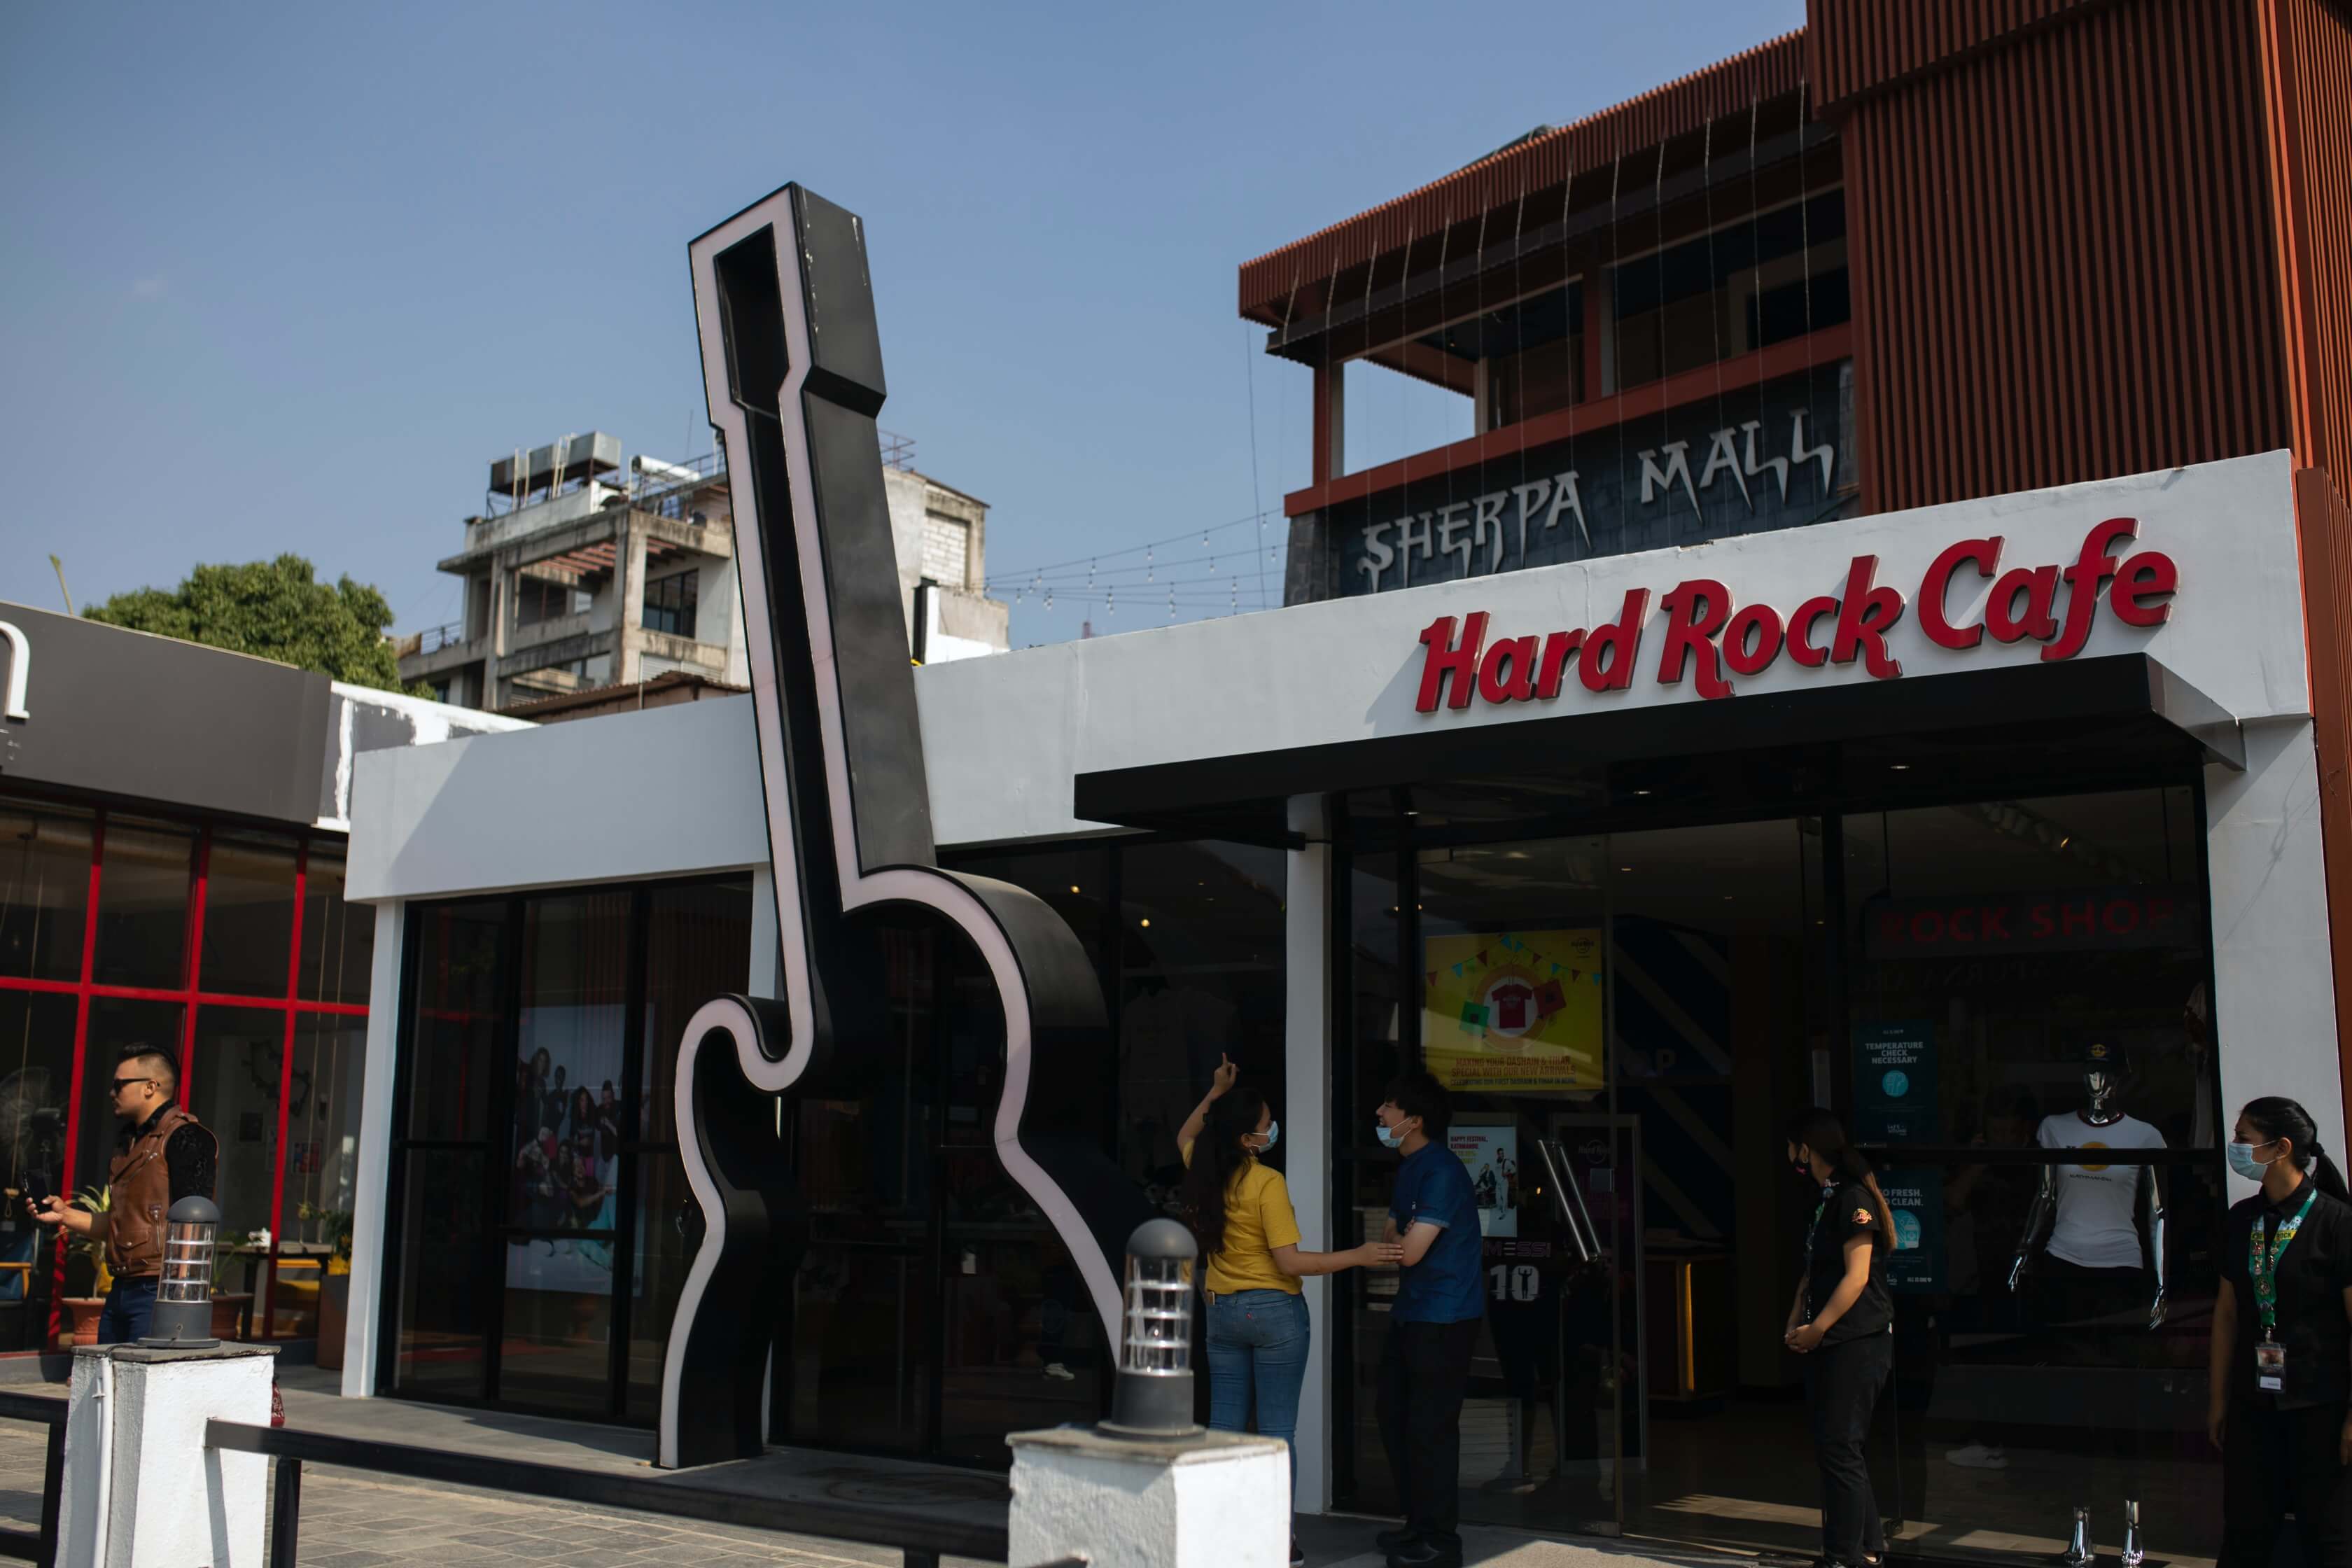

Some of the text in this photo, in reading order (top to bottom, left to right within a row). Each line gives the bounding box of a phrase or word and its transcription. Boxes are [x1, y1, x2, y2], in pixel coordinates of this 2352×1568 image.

[1359, 407, 1834, 594] SHERPA MALL
[1415, 517, 2179, 714] Hard Rock Cafe
[1881, 897, 2174, 943] ROCK SHOP
[1865, 1042, 1924, 1050] TEMPERATURE
[1872, 1056, 1918, 1065] NECESSARY
[1451, 1065, 1575, 1077] SPECIAL WITH OUR NEW ARRIVALS
[1891, 1189, 1923, 1197] FRESH.
[1891, 1198, 1924, 1206] CLEAN.
[1482, 1240, 1551, 1258] MESSI
[1490, 1264, 1541, 1302] 10
